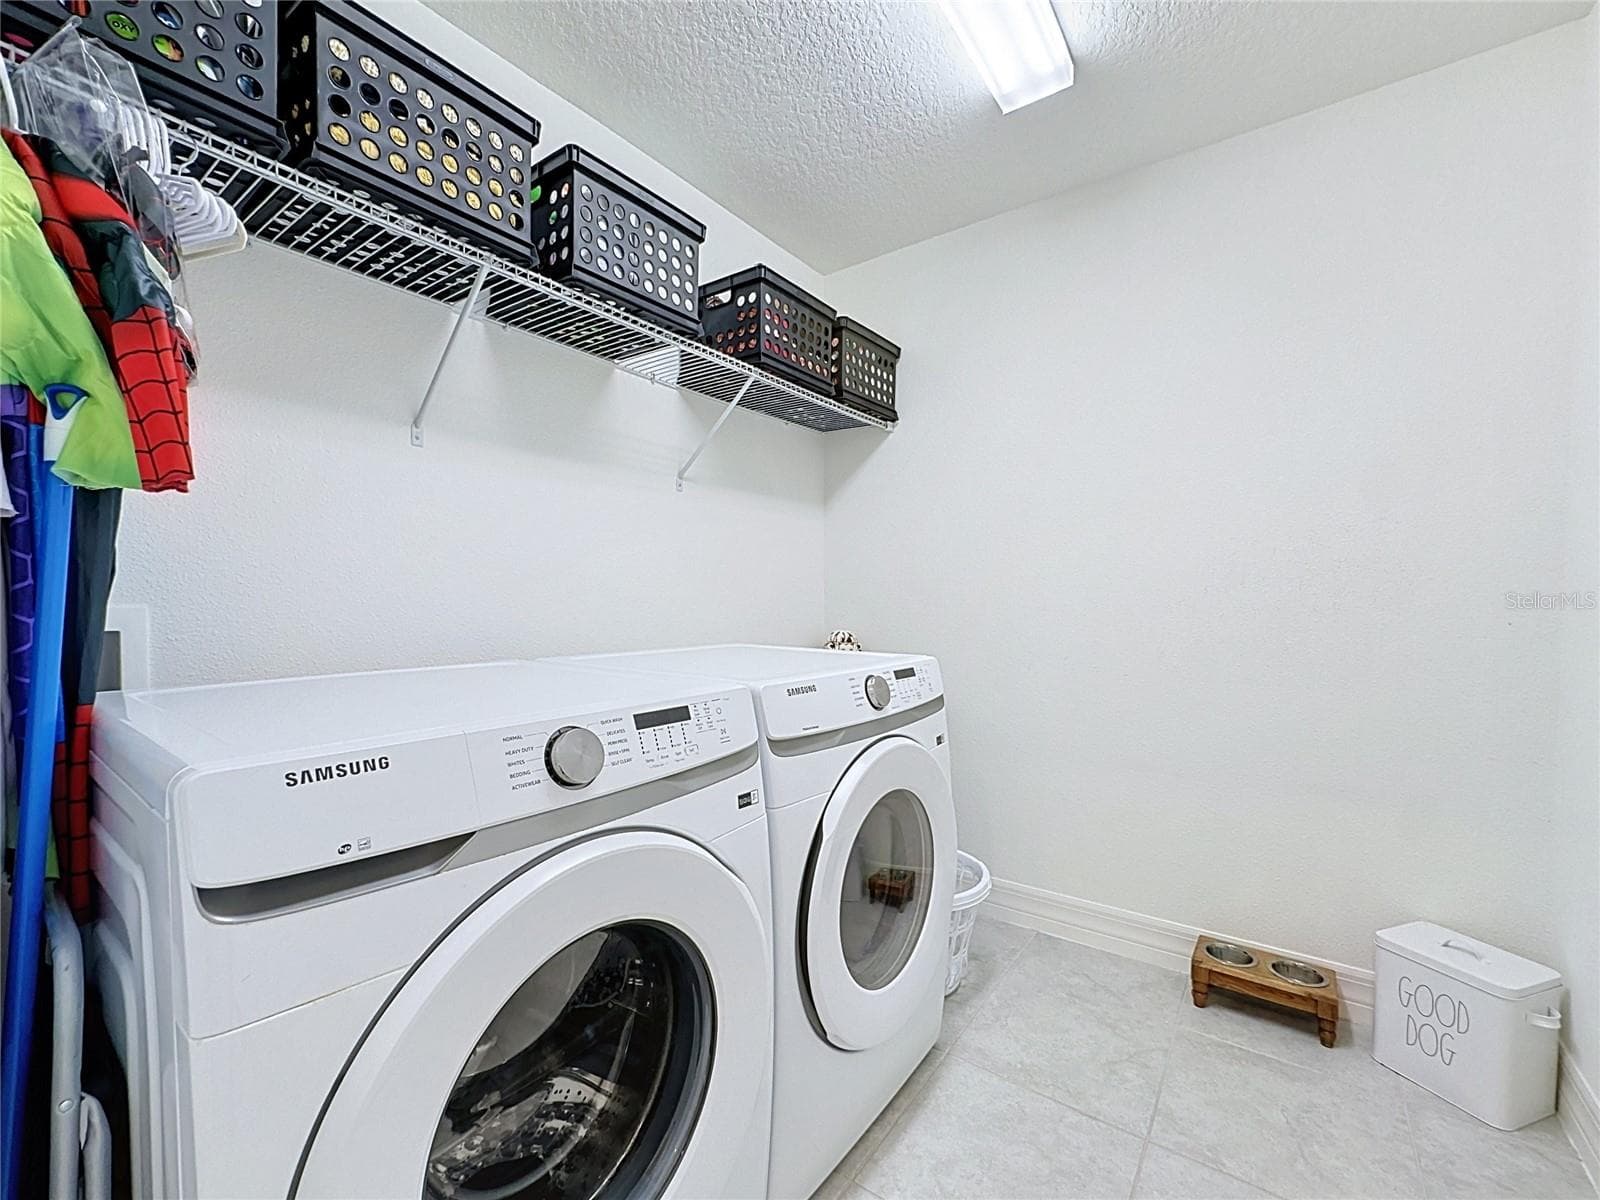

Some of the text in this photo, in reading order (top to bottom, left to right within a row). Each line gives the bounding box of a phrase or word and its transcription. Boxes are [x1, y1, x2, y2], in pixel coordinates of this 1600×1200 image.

[786, 684, 817, 697] SAMSUNG
[502, 735, 524, 743] NORMAL
[505, 748, 521, 756] HEAVY
[507, 759, 526, 767] WHITES
[284, 756, 390, 787] SAMSUNG
[509, 769, 532, 779] BEDDING
[511, 779, 541, 791] ACTIVEWEAR
[1398, 976, 1470, 1034] GOOD
[1406, 1014, 1457, 1066] DOG
